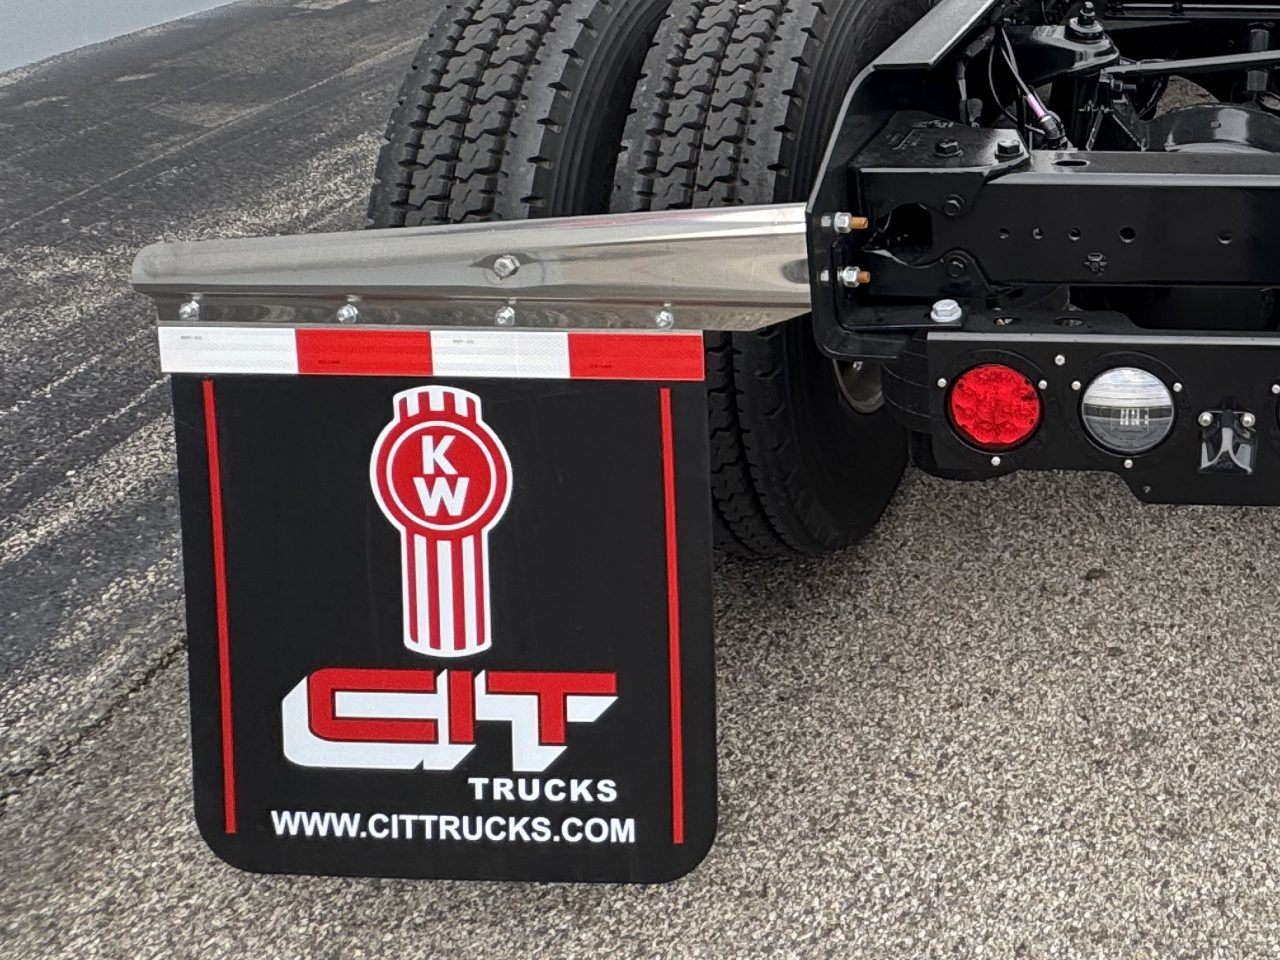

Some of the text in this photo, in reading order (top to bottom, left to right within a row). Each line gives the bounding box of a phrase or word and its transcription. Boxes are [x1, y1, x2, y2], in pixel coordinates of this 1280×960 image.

[282, 668, 619, 772] CIT
[468, 777, 618, 803] TRUCKS
[270, 810, 636, 843] WWW.CITTRUCKS.COM
